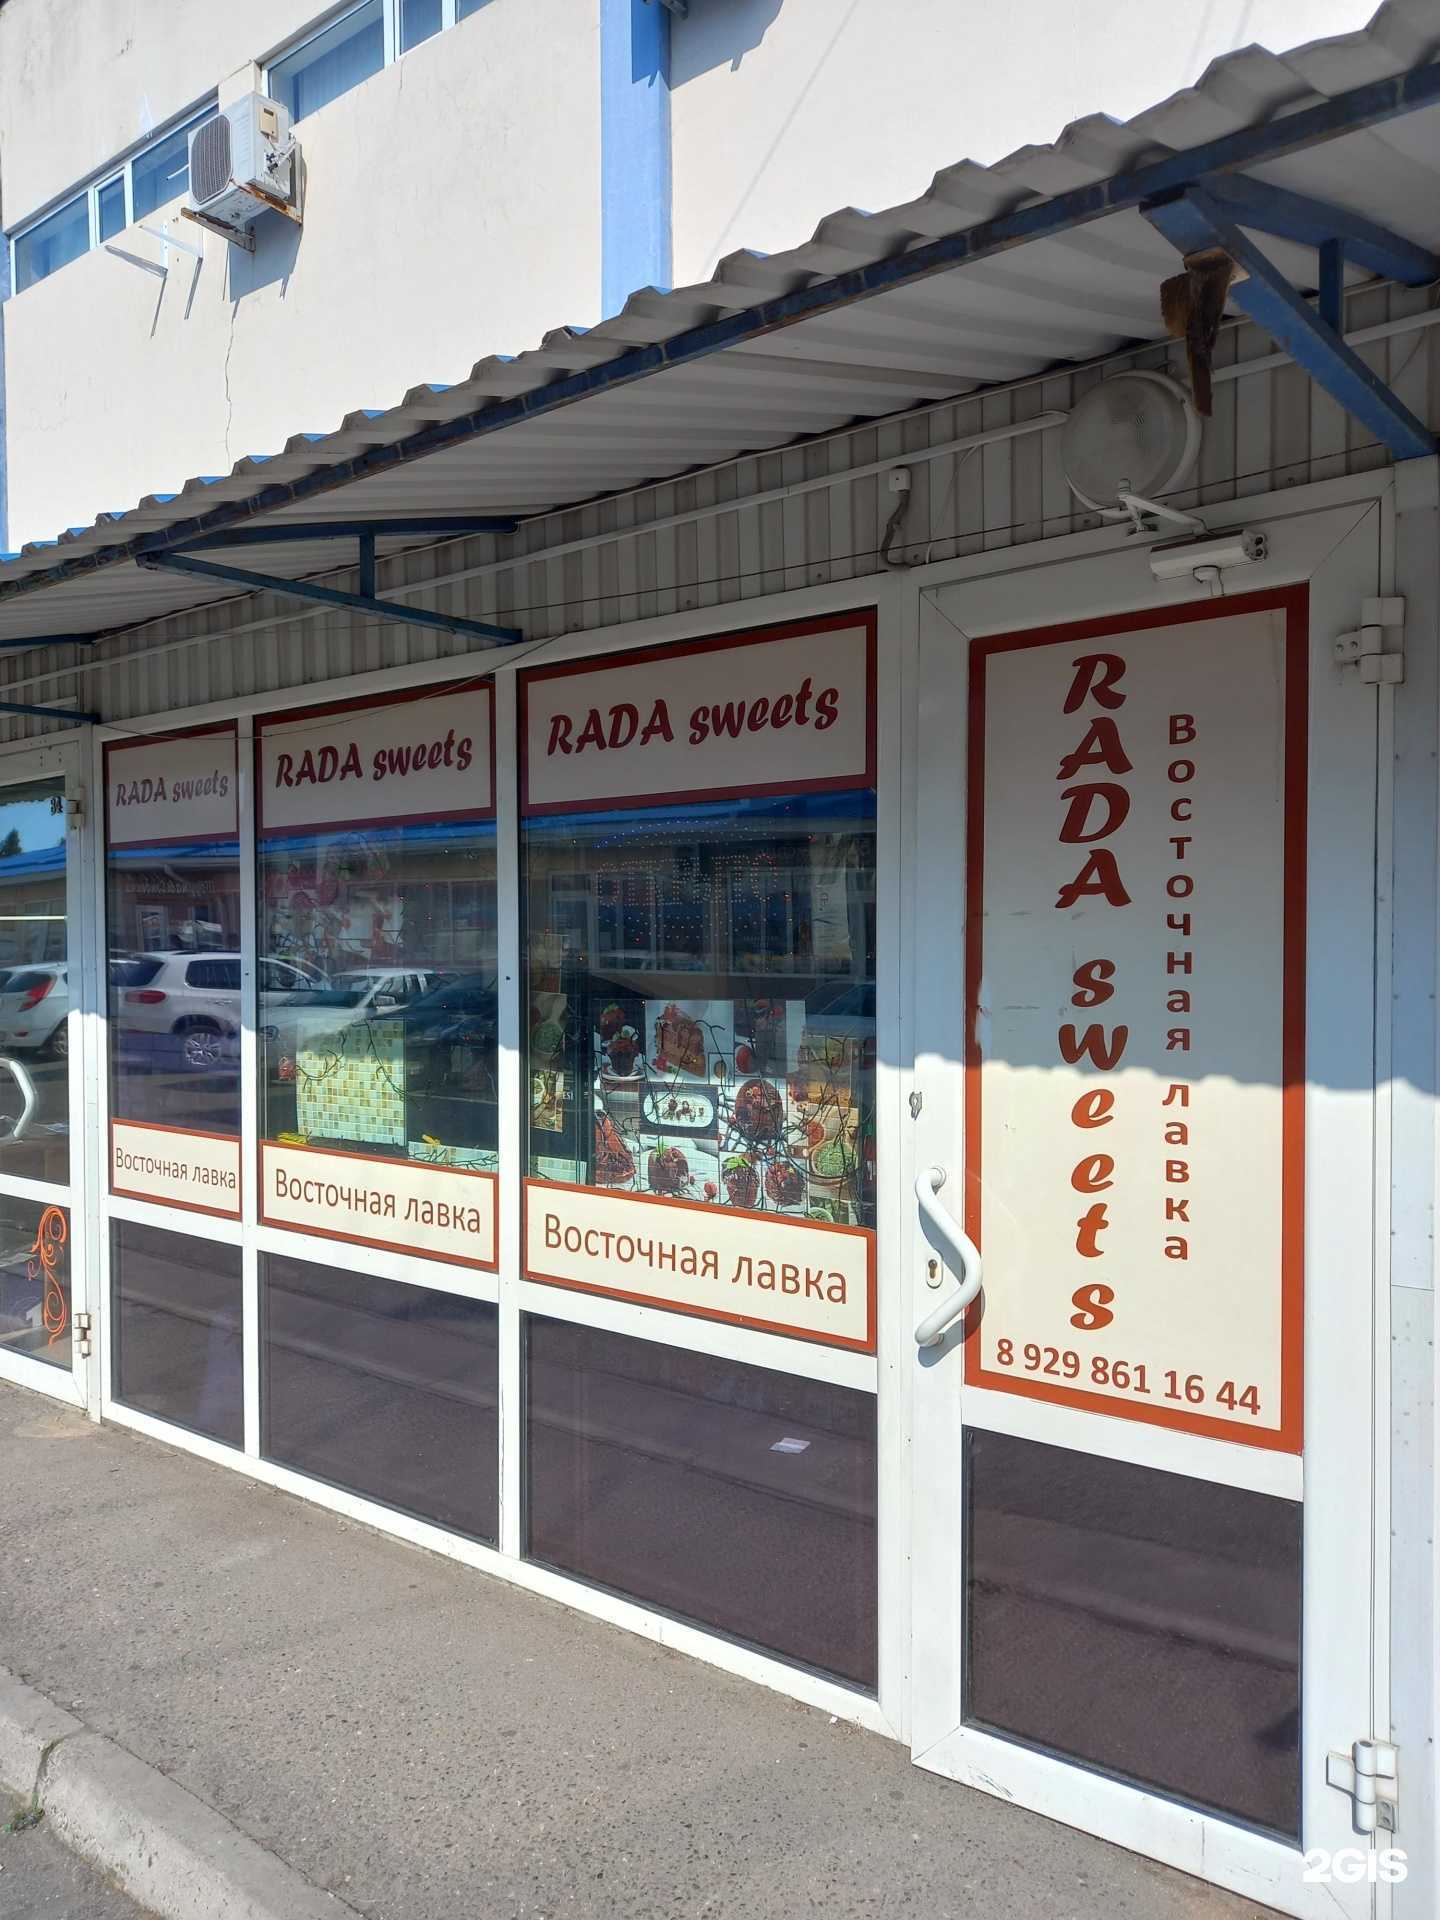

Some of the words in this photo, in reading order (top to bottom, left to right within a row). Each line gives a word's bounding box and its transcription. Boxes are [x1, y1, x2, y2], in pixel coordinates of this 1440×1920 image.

[548, 699, 674, 756] RADA
[689, 678, 839, 746] sweets
[115, 777, 167, 807] RADA
[172, 769, 229, 803] sweets
[276, 743, 364, 788] RADA
[373, 729, 473, 782] sweets
[1055, 654, 1133, 908] RADA
[1166, 714, 1197, 1050] Восточная
[115, 1148, 188, 1182] Восточная
[192, 1166, 236, 1190] лавка
[1059, 959, 1129, 1330] sweets
[1162, 1084, 1190, 1260] лавка
[275, 1168, 396, 1218] Восточная
[404, 1198, 481, 1234] лавка
[545, 1213, 719, 1279] Восточная
[732, 1256, 847, 1305] лавка
[997, 1339, 1014, 1366] 8
[1022, 1345, 1080, 1380] 929
[1090, 1357, 1151, 1394] 861
[1165, 1371, 1205, 1404] 16
[1216, 1381, 1261, 1417] 44
